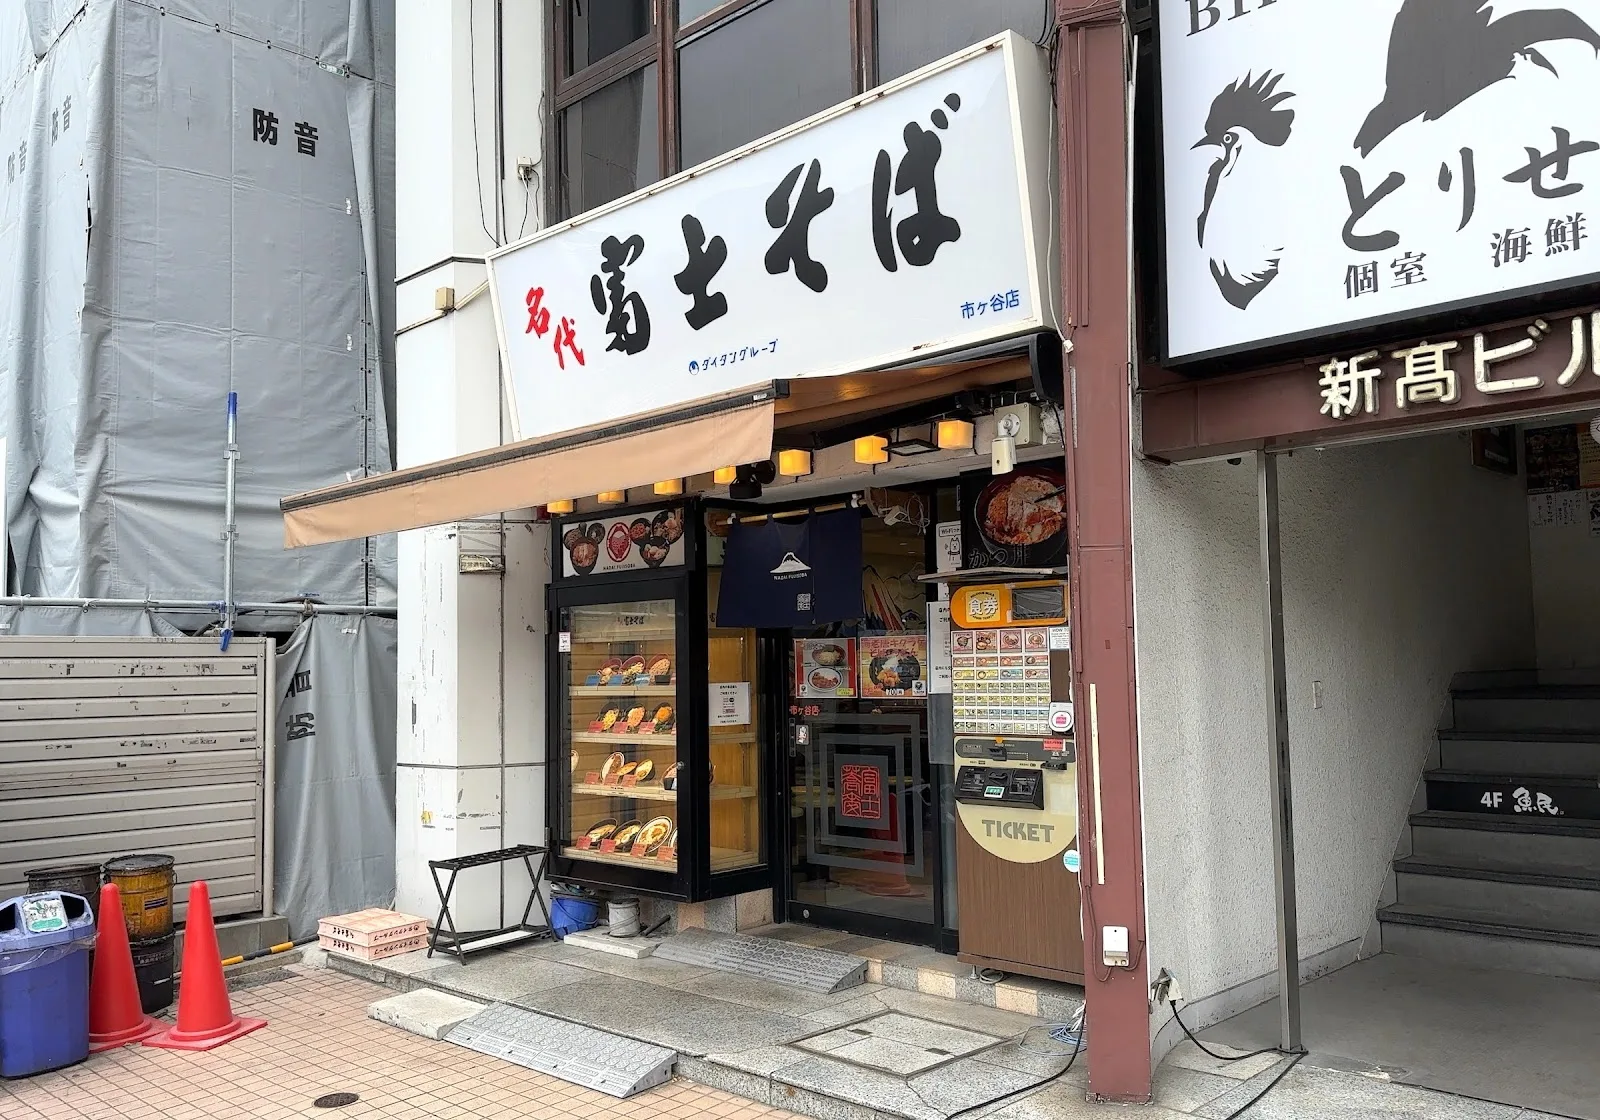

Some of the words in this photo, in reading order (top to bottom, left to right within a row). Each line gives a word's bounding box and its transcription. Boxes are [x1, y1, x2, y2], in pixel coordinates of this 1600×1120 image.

[52, 95, 71, 147] 防音
[252, 107, 319, 157] 防音
[1339, 125, 1600, 252] とりせ
[590, 92, 962, 355] 富士そば
[1343, 251, 1428, 299] 個室
[1490, 212, 1588, 267] 海鮮
[525, 286, 585, 370] 名代
[702, 339, 778, 371] ダイタングループ
[968, 597, 999, 616] 食券
[1481, 792, 1502, 808] 4F
[1512, 787, 1558, 815] 魚民
[981, 819, 1054, 843] TICKET
